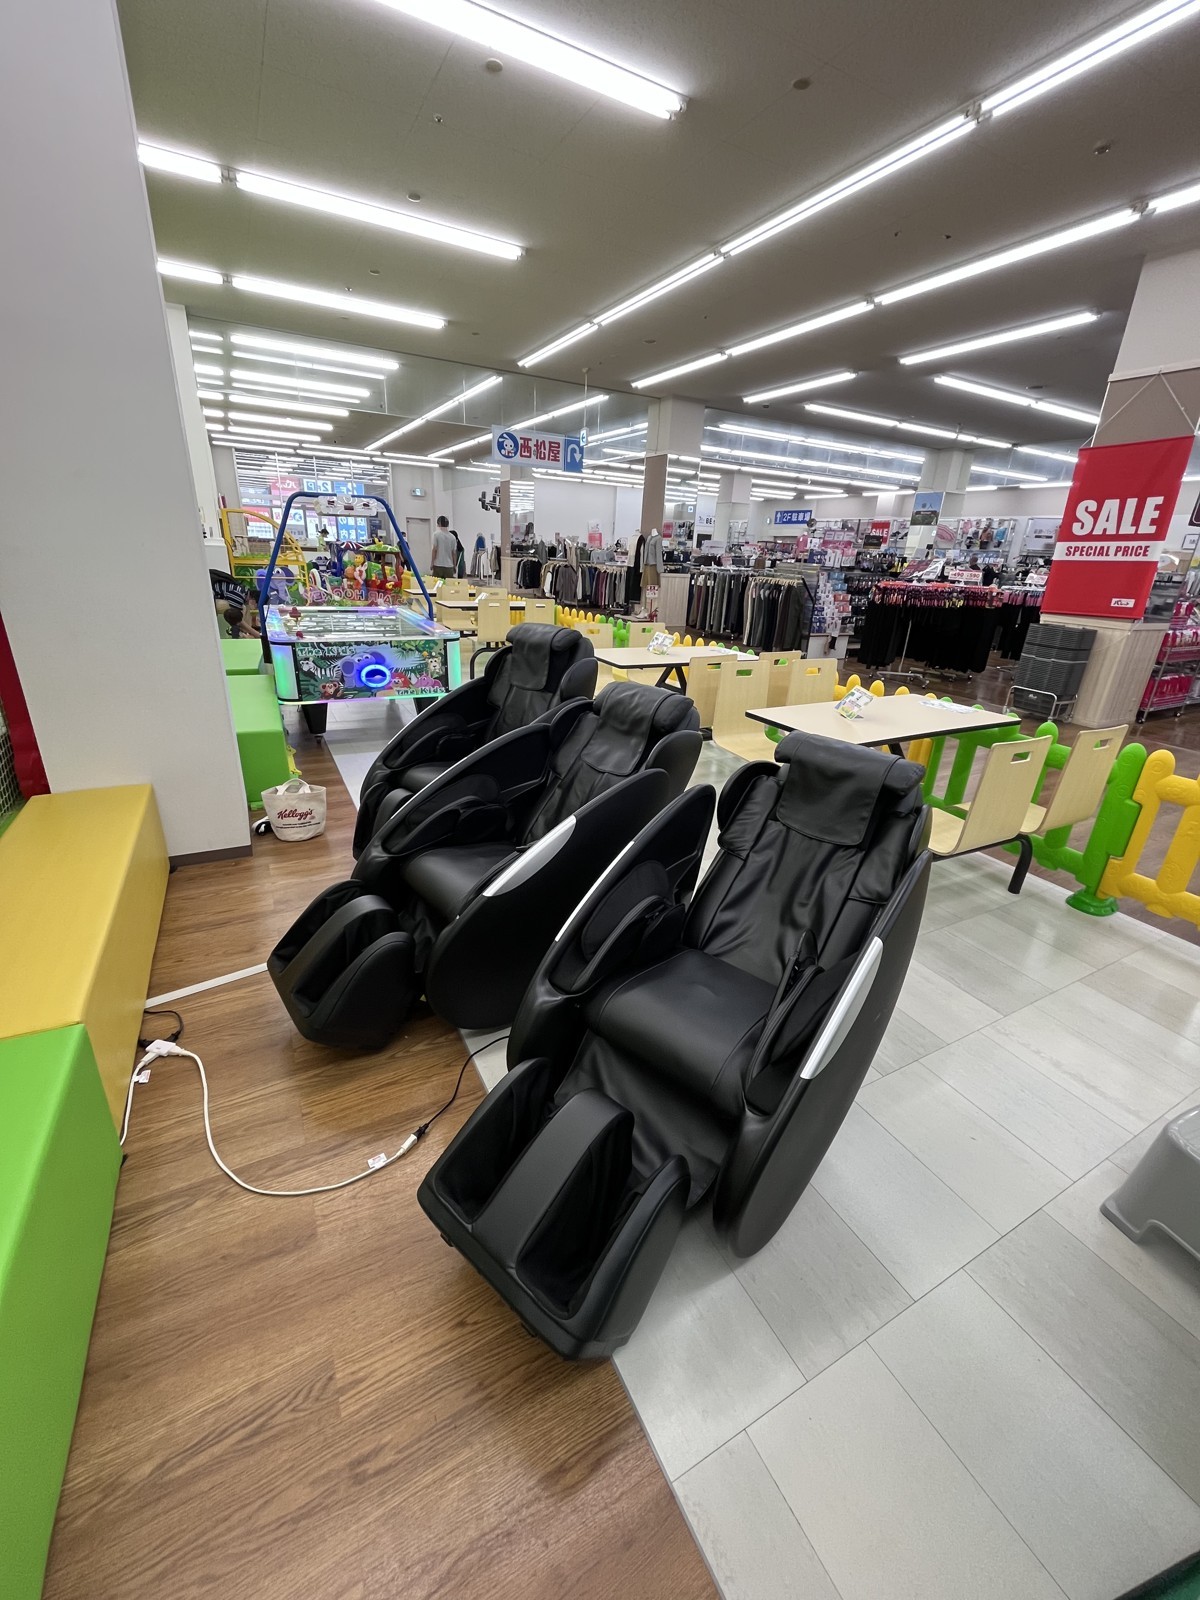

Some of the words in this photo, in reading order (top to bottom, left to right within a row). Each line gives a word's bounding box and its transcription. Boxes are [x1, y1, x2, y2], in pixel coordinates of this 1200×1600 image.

[519, 436, 560, 462] 西松屋
[1072, 496, 1164, 536] SALE
[870, 528, 888, 537] SALE
[1065, 545, 1110, 557] SPECIAL
[1114, 545, 1150, 557] PRICE
[297, 647, 321, 657] The
[325, 646, 355, 657] Kids
[419, 685, 445, 695] Kids
[277, 808, 314, 820] Kellogg's
